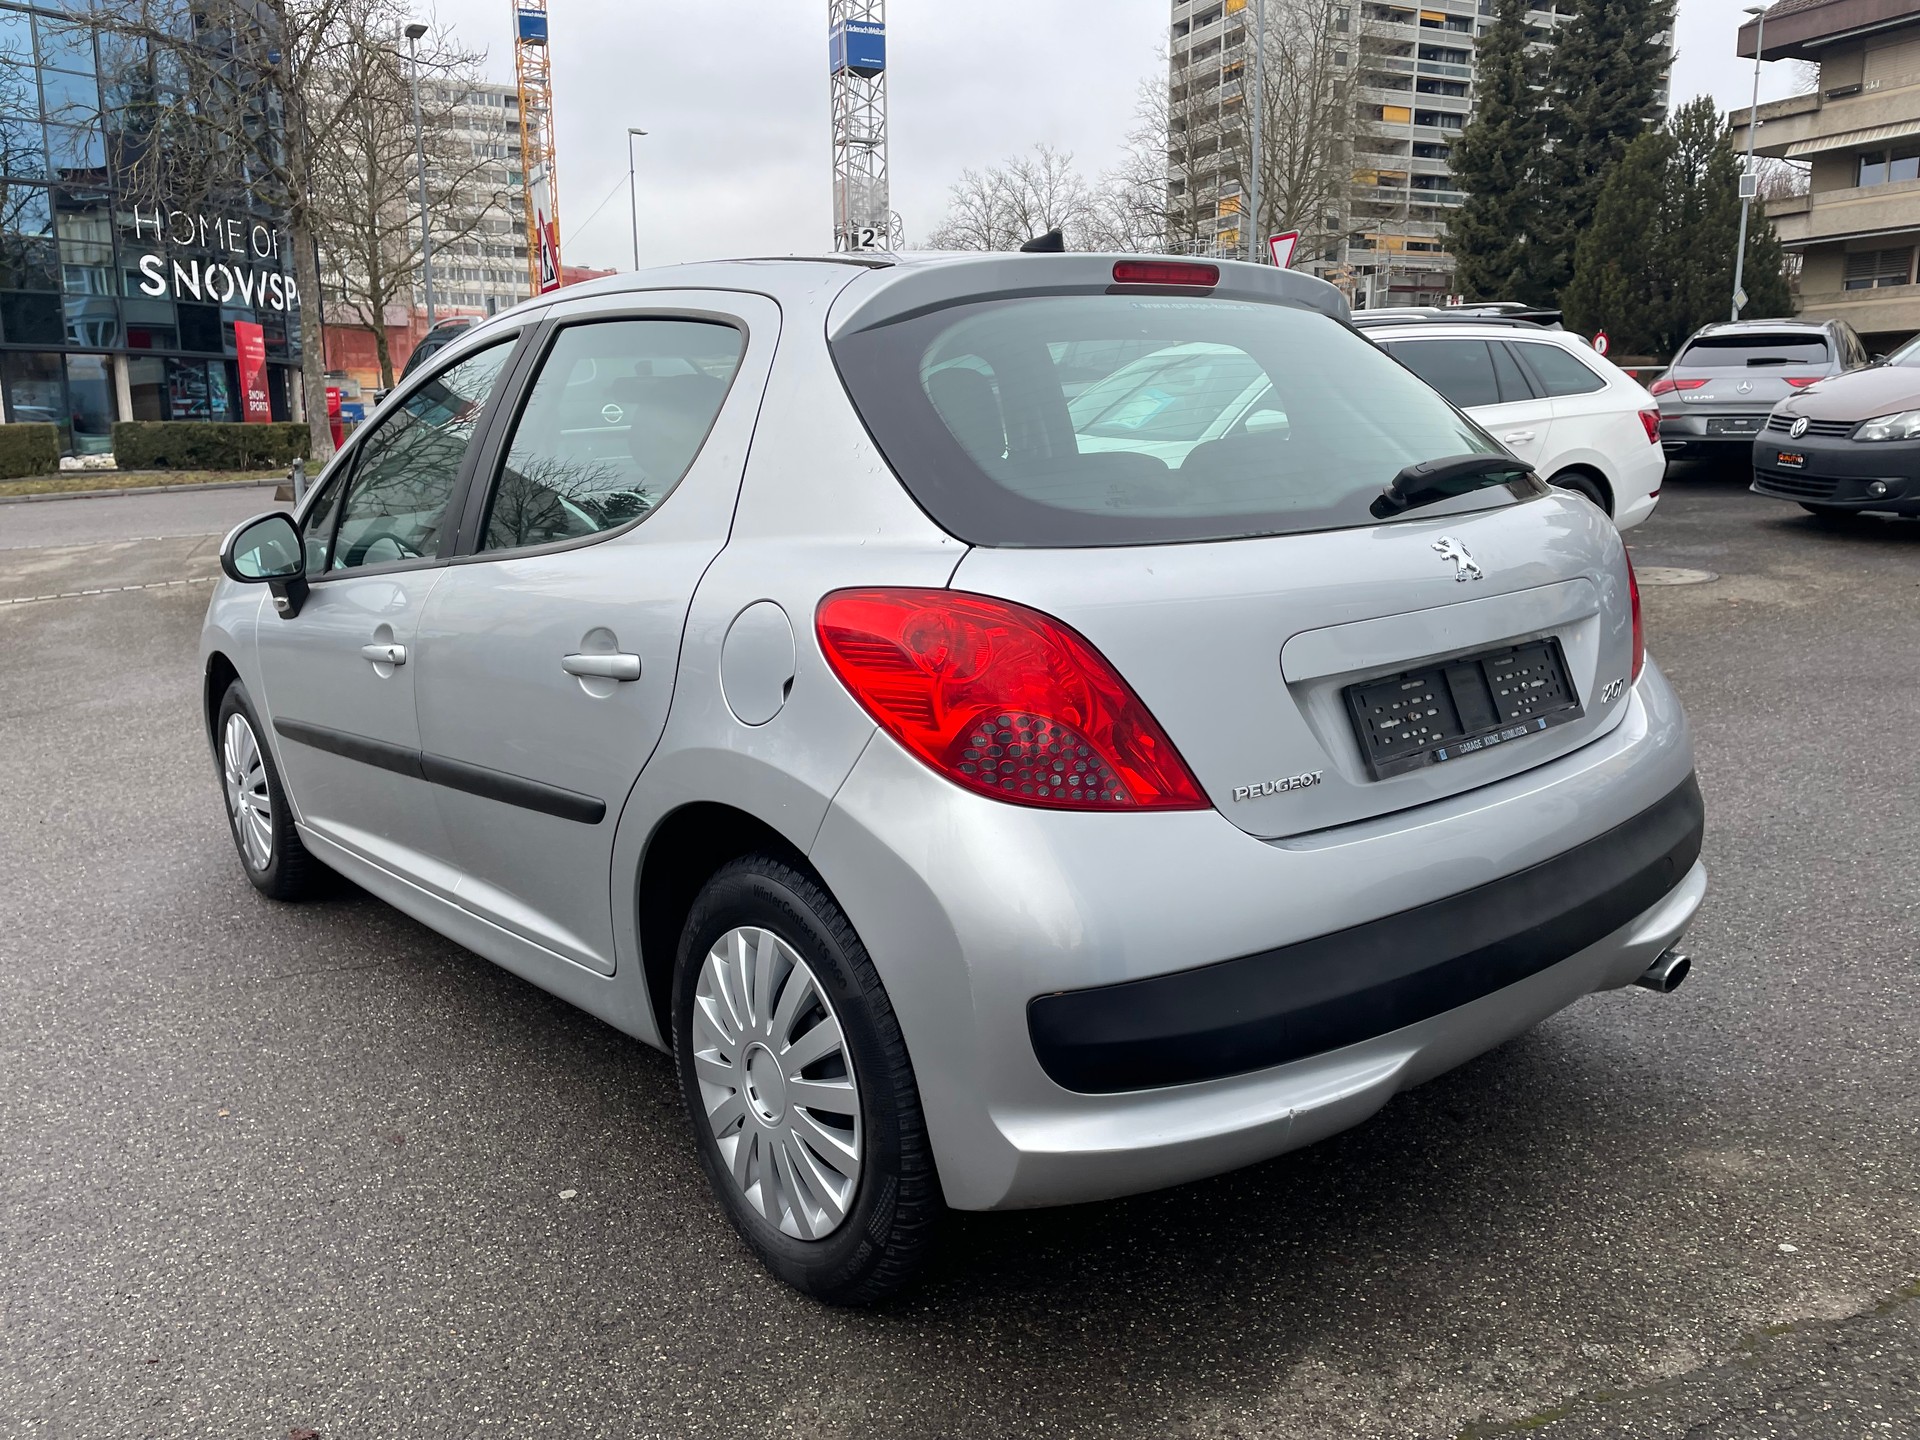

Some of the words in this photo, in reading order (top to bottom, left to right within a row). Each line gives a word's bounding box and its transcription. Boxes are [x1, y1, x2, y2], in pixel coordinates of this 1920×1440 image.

[134, 204, 245, 254] HOME
[862, 229, 875, 247] 2
[139, 254, 301, 312] SNOWSP
[249, 389, 266, 400] SNOW-
[249, 400, 269, 412] SPORTS
[1459, 739, 1483, 754] GARAGE
[1484, 733, 1500, 746] KUNZ
[1233, 770, 1323, 802] PEUGEOT
[753, 884, 818, 941] WinterContact
